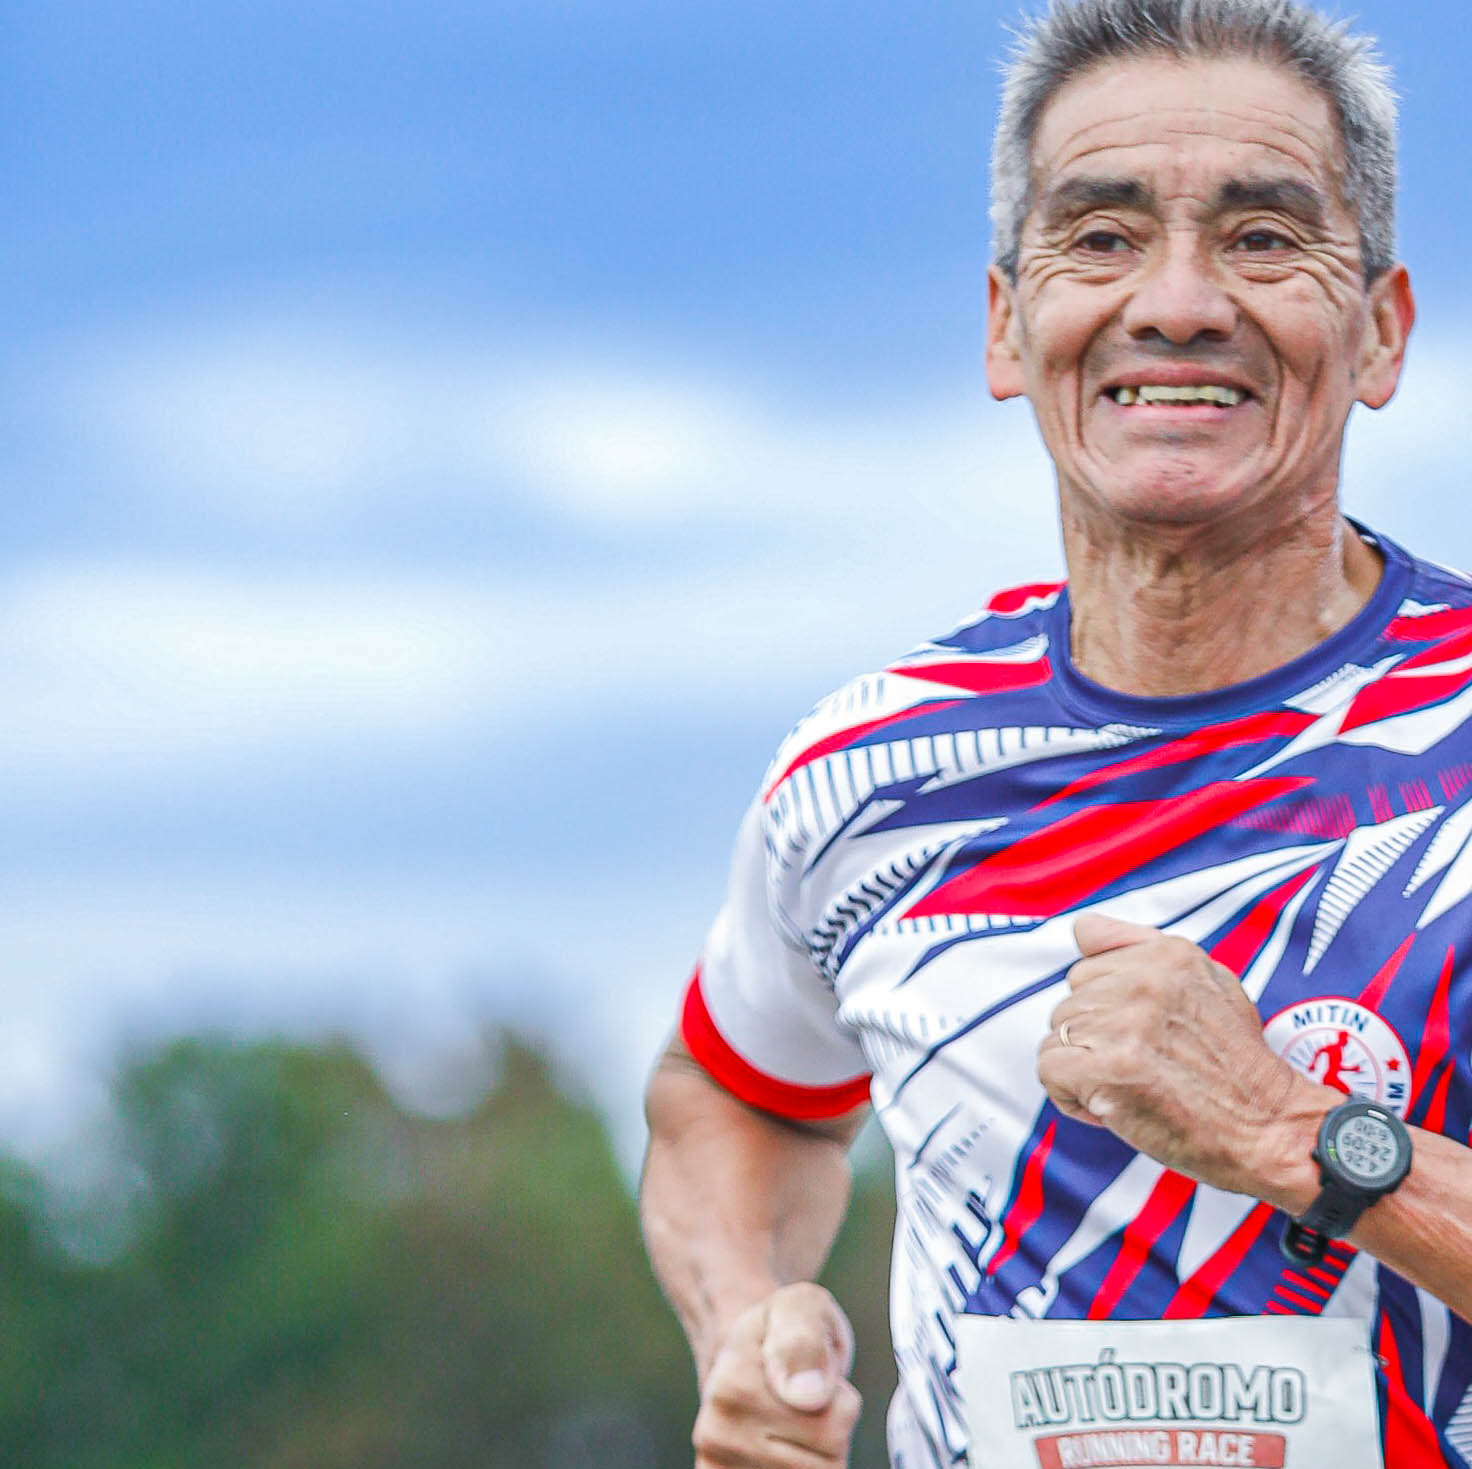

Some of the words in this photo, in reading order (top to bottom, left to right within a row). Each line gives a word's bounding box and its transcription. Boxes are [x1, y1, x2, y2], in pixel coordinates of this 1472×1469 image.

[1292, 1003, 1371, 1033] MITIN
[1009, 1346, 1308, 1428] AUTÓDROMO
[1056, 1430, 1172, 1469] RUNNING
[1176, 1431, 1256, 1466] RACE
